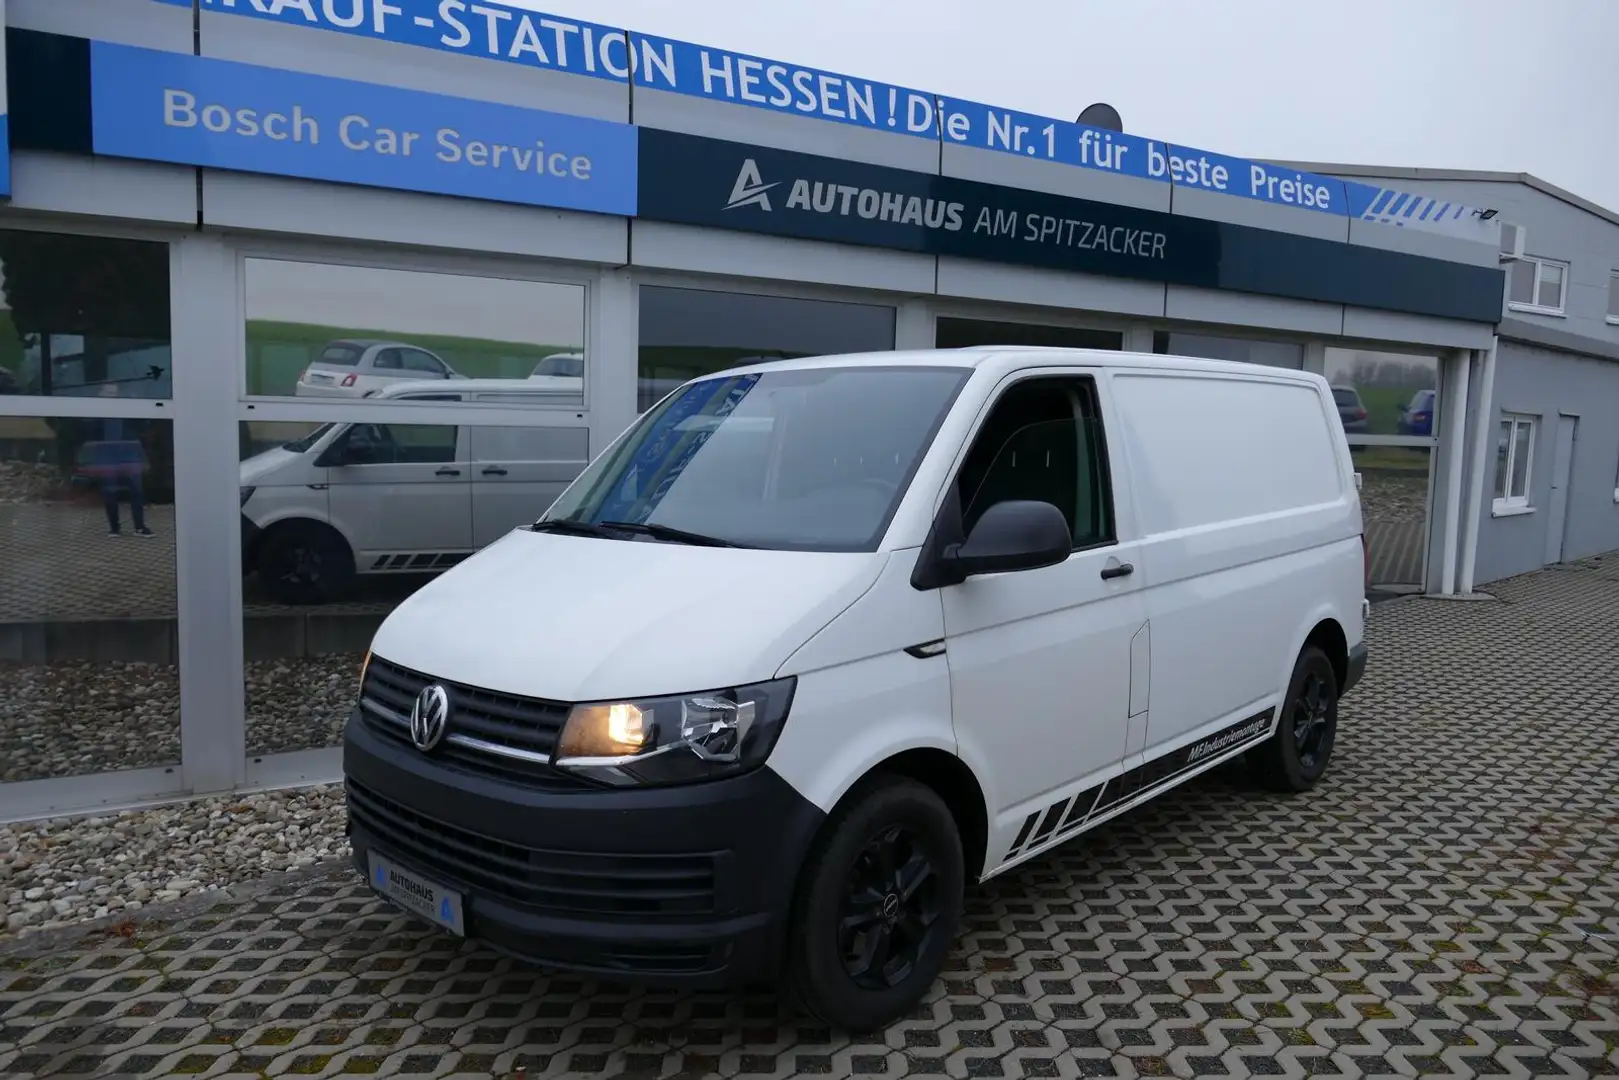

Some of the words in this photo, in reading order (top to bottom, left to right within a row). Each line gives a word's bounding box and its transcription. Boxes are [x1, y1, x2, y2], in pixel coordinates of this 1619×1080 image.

[163, 88, 319, 145] Bosch
[340, 115, 420, 157] Car
[436, 129, 593, 181] Service
[205, 0, 676, 87] UF-STATION
[1079, 129, 1128, 170] für
[1147, 142, 1229, 190] beste
[1251, 165, 1331, 209] Preise
[786, 179, 965, 232] AUTOHAUS
[973, 206, 1016, 239] AM
[1024, 213, 1167, 259] SPITZACKER
[390, 869, 434, 902] AUTOHAUS
